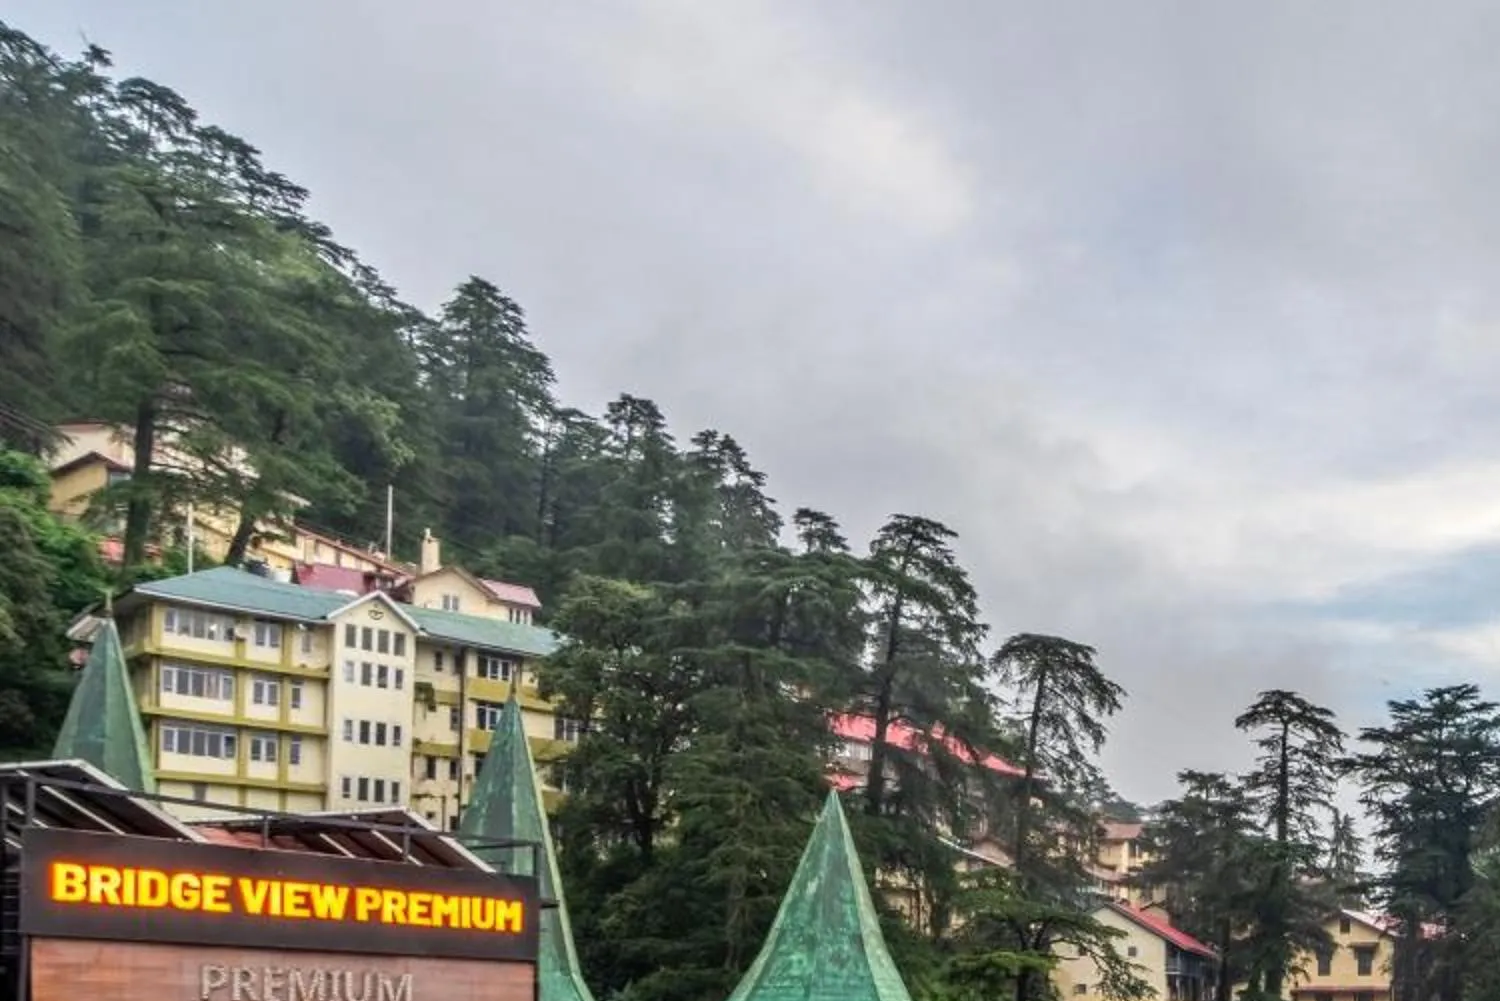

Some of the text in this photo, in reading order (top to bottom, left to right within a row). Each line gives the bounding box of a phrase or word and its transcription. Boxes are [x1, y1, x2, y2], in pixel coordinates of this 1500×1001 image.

[51, 862, 523, 933] BRIDGE VIEW PREMIUM
